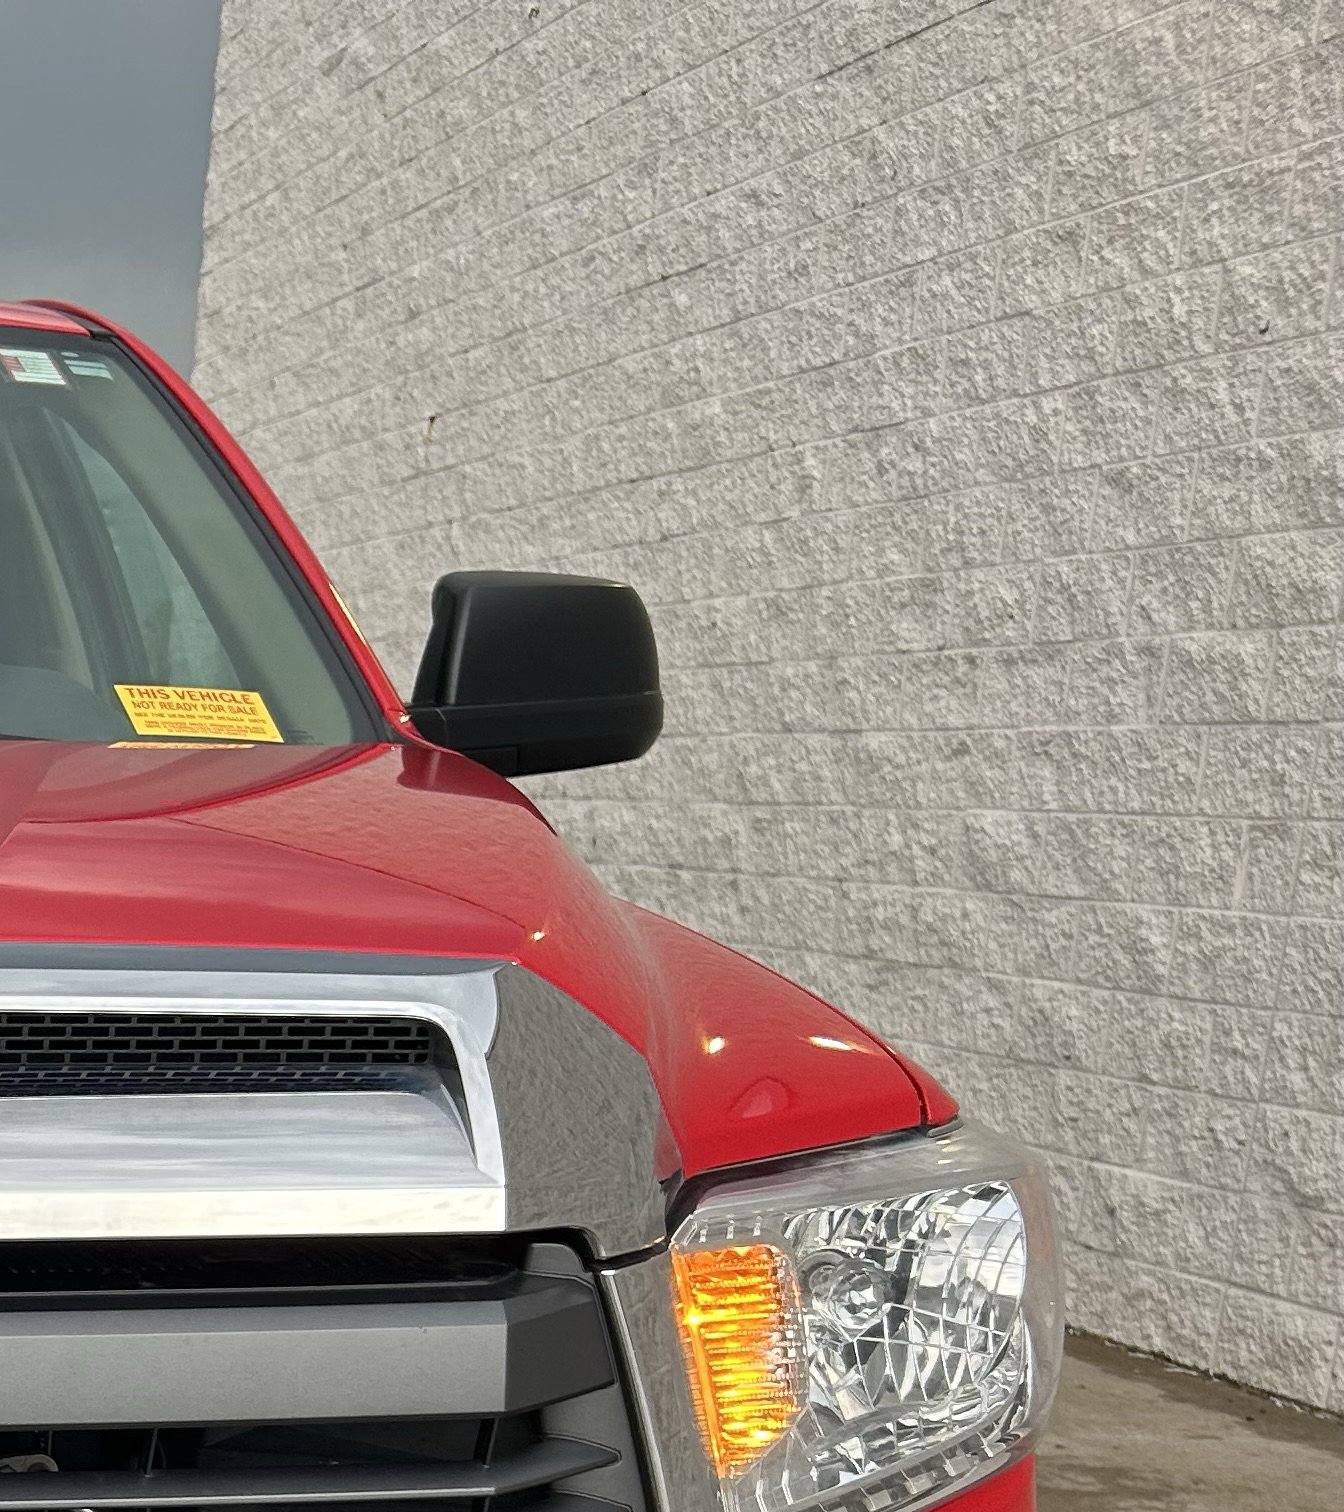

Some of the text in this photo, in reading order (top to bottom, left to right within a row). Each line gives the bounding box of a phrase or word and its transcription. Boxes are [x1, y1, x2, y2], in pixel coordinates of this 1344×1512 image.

[124, 687, 255, 705] THIS VEHICLE
[131, 700, 259, 716] NOT READY FOR SALE
